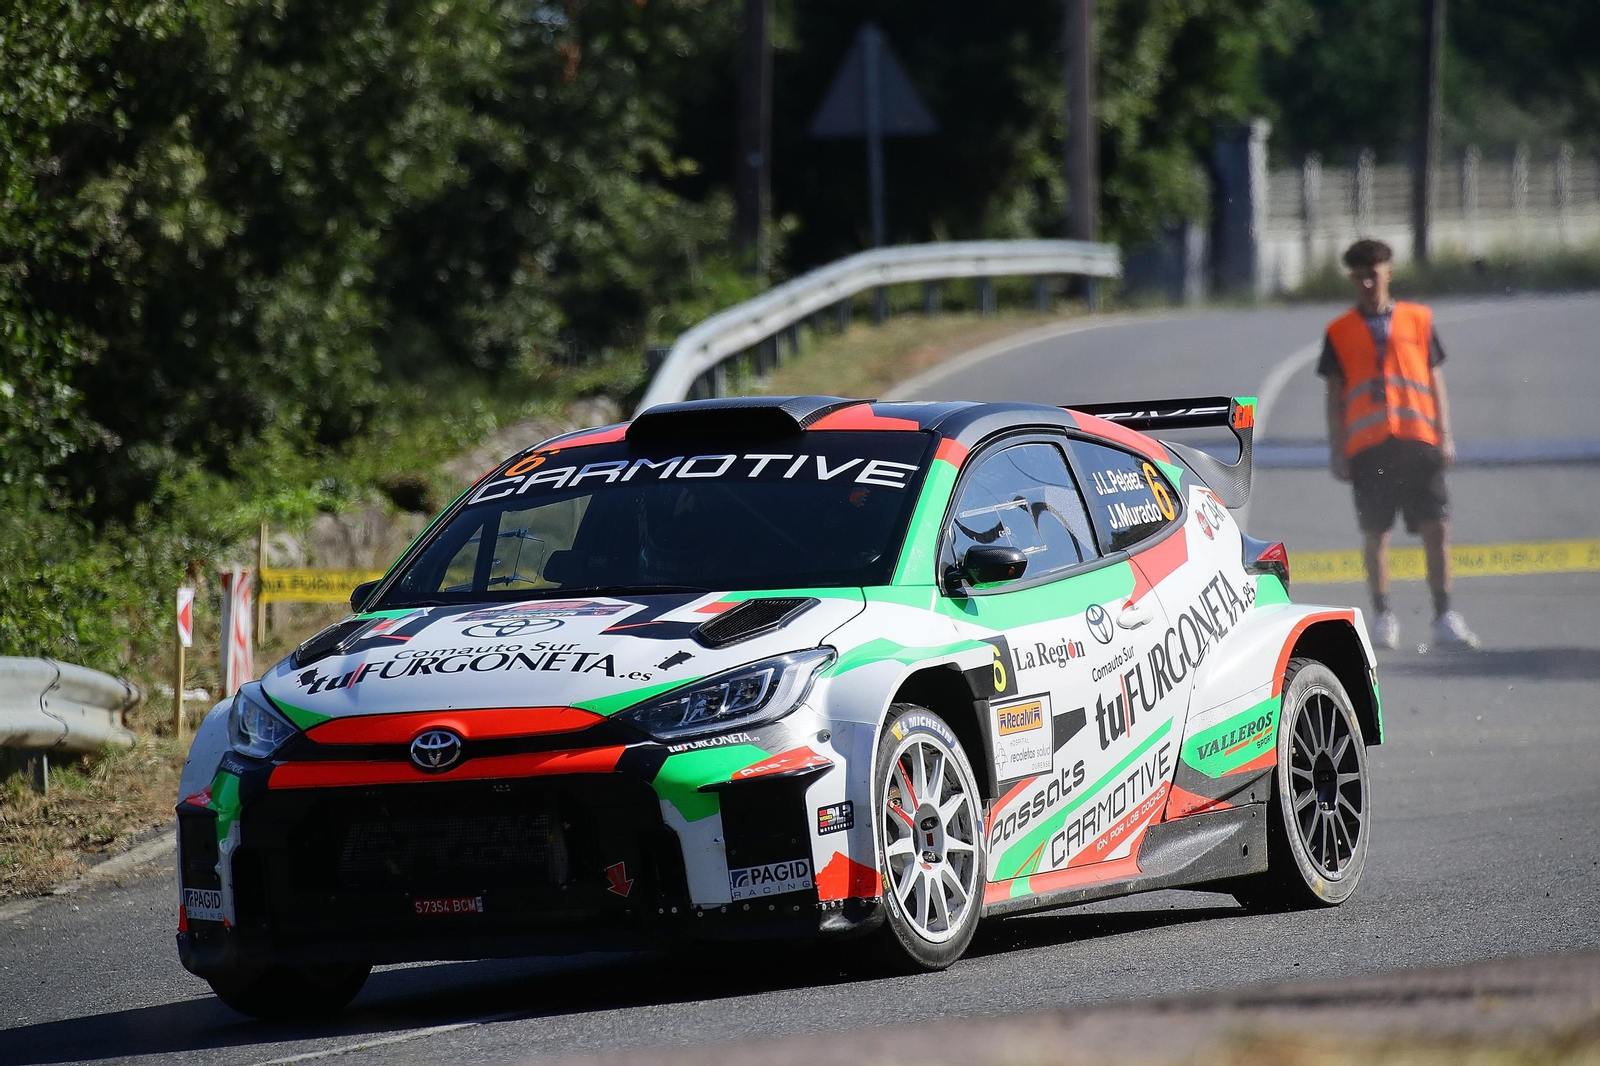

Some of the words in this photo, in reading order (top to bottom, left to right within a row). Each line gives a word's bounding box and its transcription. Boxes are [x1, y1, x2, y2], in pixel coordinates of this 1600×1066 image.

[467, 453, 921, 505] CARMOTIVE
[1092, 469, 1145, 496] J.L.Pelaez
[1142, 462, 1176, 520] 6
[1107, 498, 1163, 529] J.Murado
[394, 643, 524, 660] Comauto
[530, 641, 582, 651] Sur
[1012, 647, 1036, 672] La
[1034, 637, 1086, 669] Región
[1091, 654, 1123, 682] Comauto
[1122, 645, 1135, 662] Sur
[991, 644, 1007, 692] 6
[907, 715, 953, 744] MICHELIN
[1006, 707, 1034, 730] Recalvi
[1196, 710, 1274, 762] VALLEROS
[1256, 732, 1273, 749] SPORT
[1010, 747, 1036, 763] recoletas
[1051, 741, 1171, 869] CARMOTIVE
[819, 821, 853, 834] MOTORSPORT
[1110, 822, 1125, 841] POR
[1126, 810, 1140, 828] LOS
[750, 861, 809, 885] PAGID
[193, 890, 221, 909] PAGID
[734, 880, 811, 898] RACING
[187, 910, 223, 920] RACING
[452, 899, 476, 912] BCM
